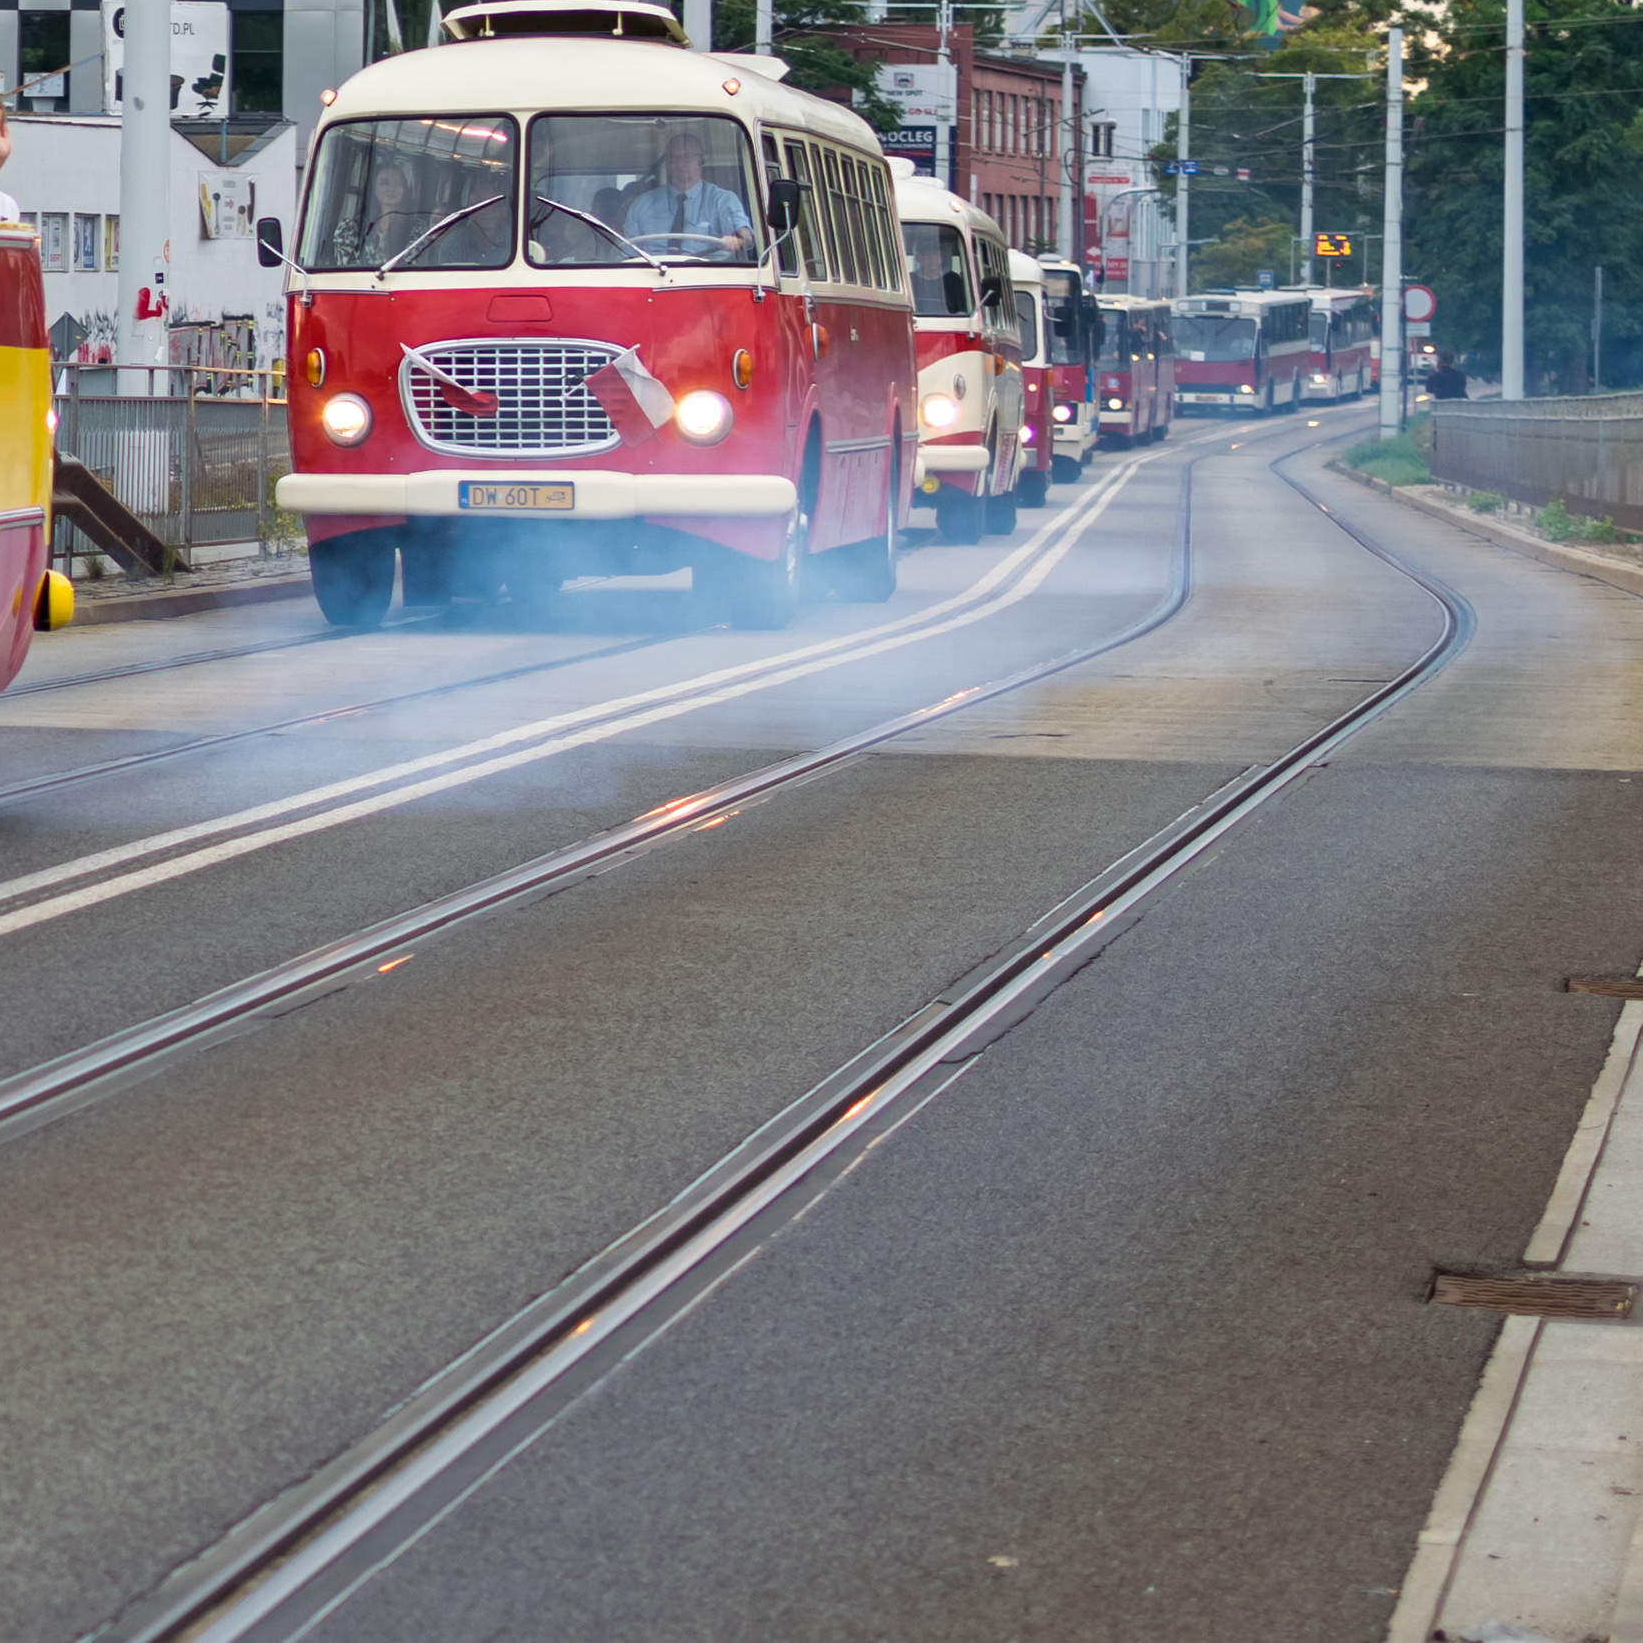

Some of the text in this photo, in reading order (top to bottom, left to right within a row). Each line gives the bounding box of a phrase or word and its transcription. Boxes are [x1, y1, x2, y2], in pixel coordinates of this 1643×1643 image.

[169, 22, 195, 35] D.PL
[473, 487, 497, 505] DW
[505, 488, 540, 506] 60T
